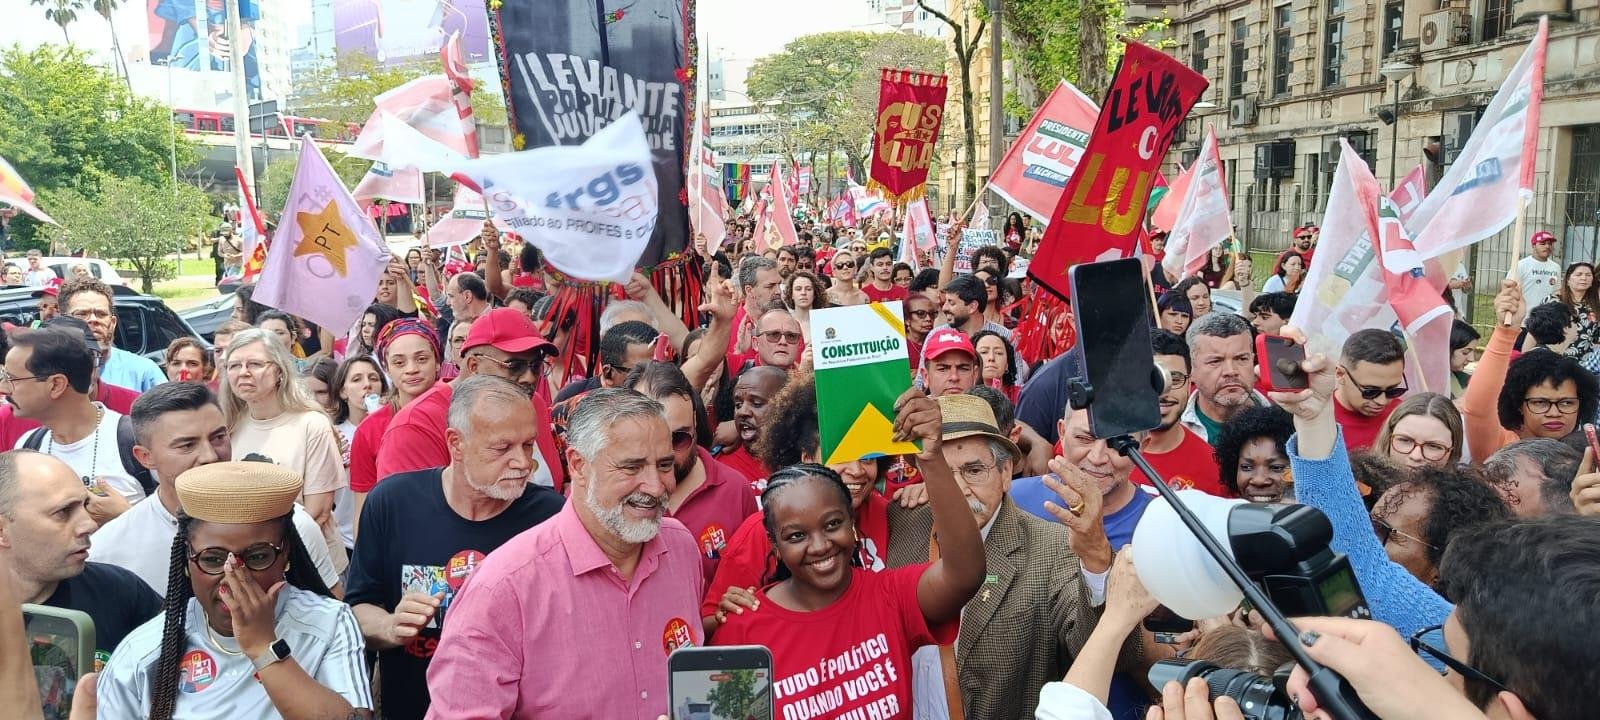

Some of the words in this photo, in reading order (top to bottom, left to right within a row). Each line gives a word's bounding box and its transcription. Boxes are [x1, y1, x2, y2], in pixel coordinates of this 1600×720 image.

[524, 52, 680, 118] LEVANTE
[1040, 119, 1090, 143] PRESIDENTE
[1027, 135, 1078, 168] LUL
[314, 222, 341, 251] PT
[821, 336, 900, 360] CONSTITUIÇÃO
[773, 667, 819, 699] TUDO
[819, 658, 827, 683] É
[828, 633, 889, 680] POLÍTICO
[782, 686, 844, 720] QUANDO
[843, 663, 889, 701] VOCÊ
[885, 657, 898, 683] É
